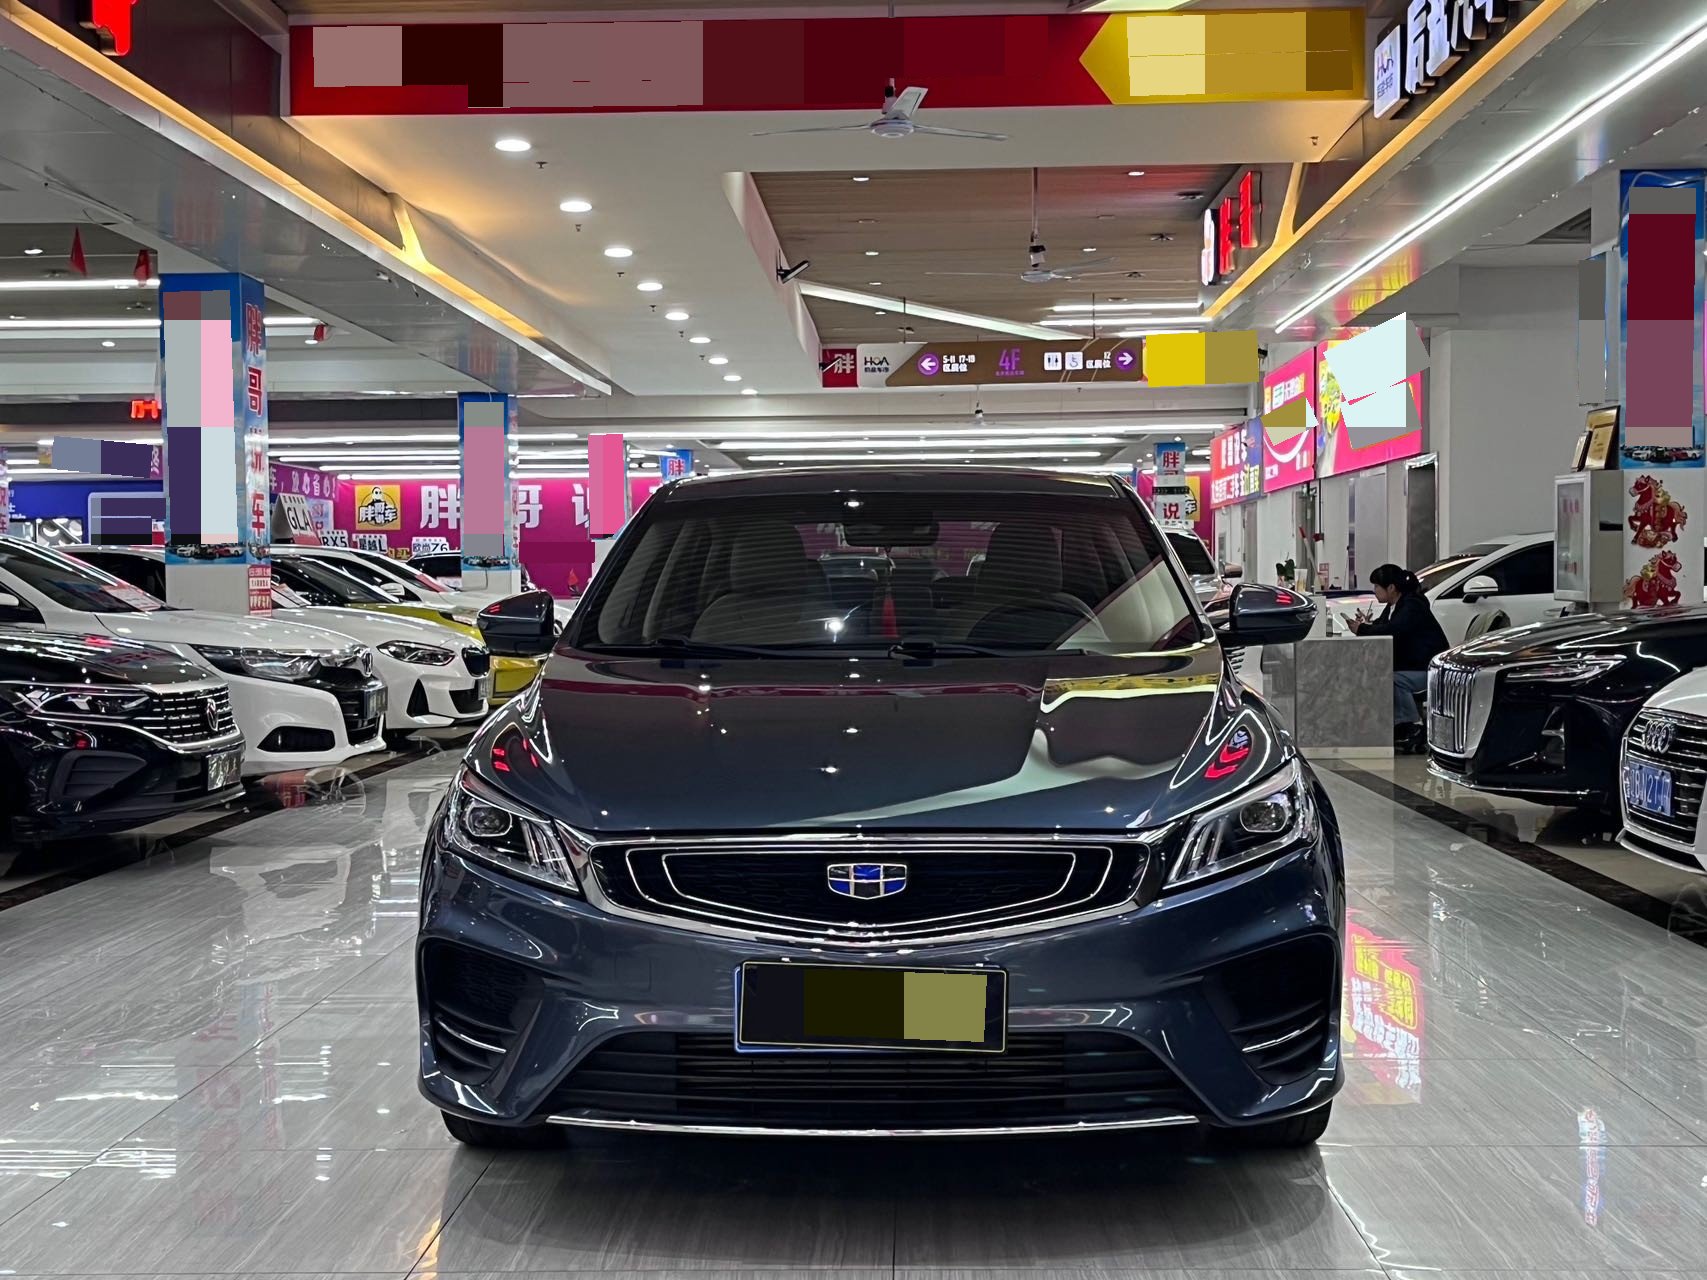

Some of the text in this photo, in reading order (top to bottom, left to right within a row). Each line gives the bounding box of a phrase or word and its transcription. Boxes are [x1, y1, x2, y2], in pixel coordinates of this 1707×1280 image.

[998, 348, 1020, 370] 4F
[287, 506, 314, 531] GLA
[322, 535, 347, 549] RX5
